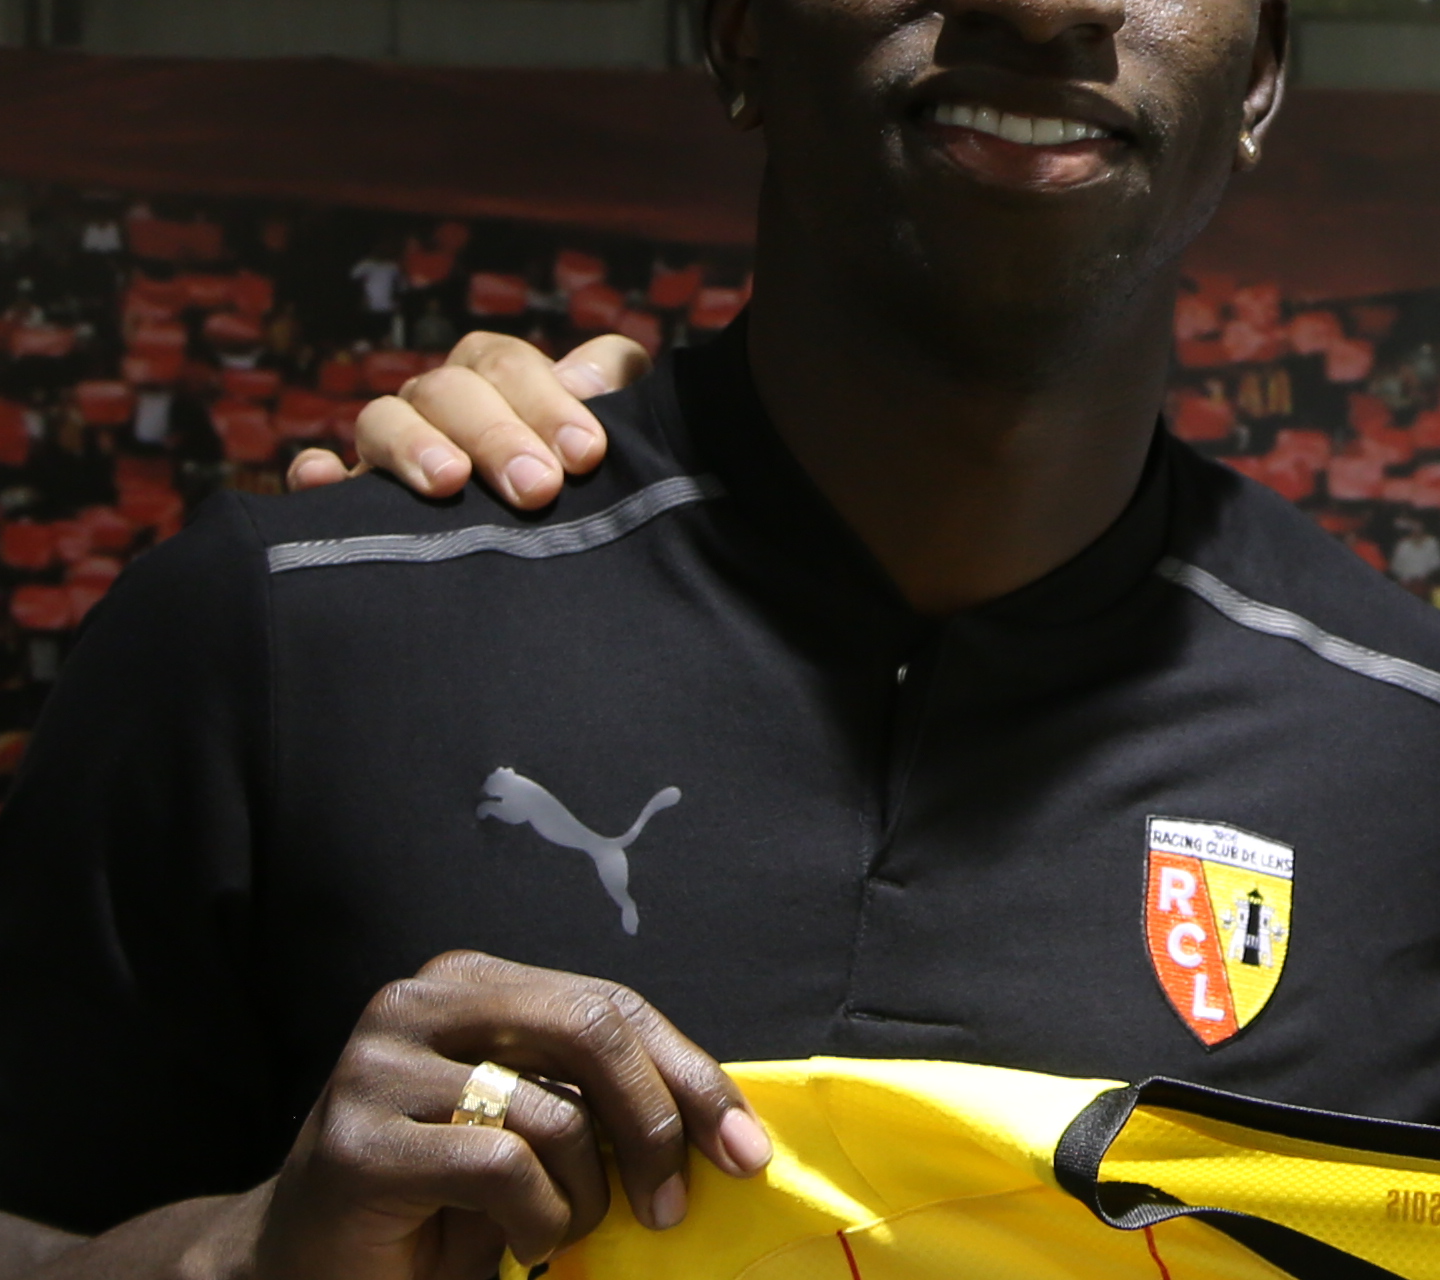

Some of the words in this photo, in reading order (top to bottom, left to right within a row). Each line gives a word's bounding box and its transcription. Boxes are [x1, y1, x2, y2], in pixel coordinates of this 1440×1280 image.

[1152, 830, 1202, 852] RACING
[1206, 841, 1239, 860] CLUB
[1242, 848, 1257, 865] DE
